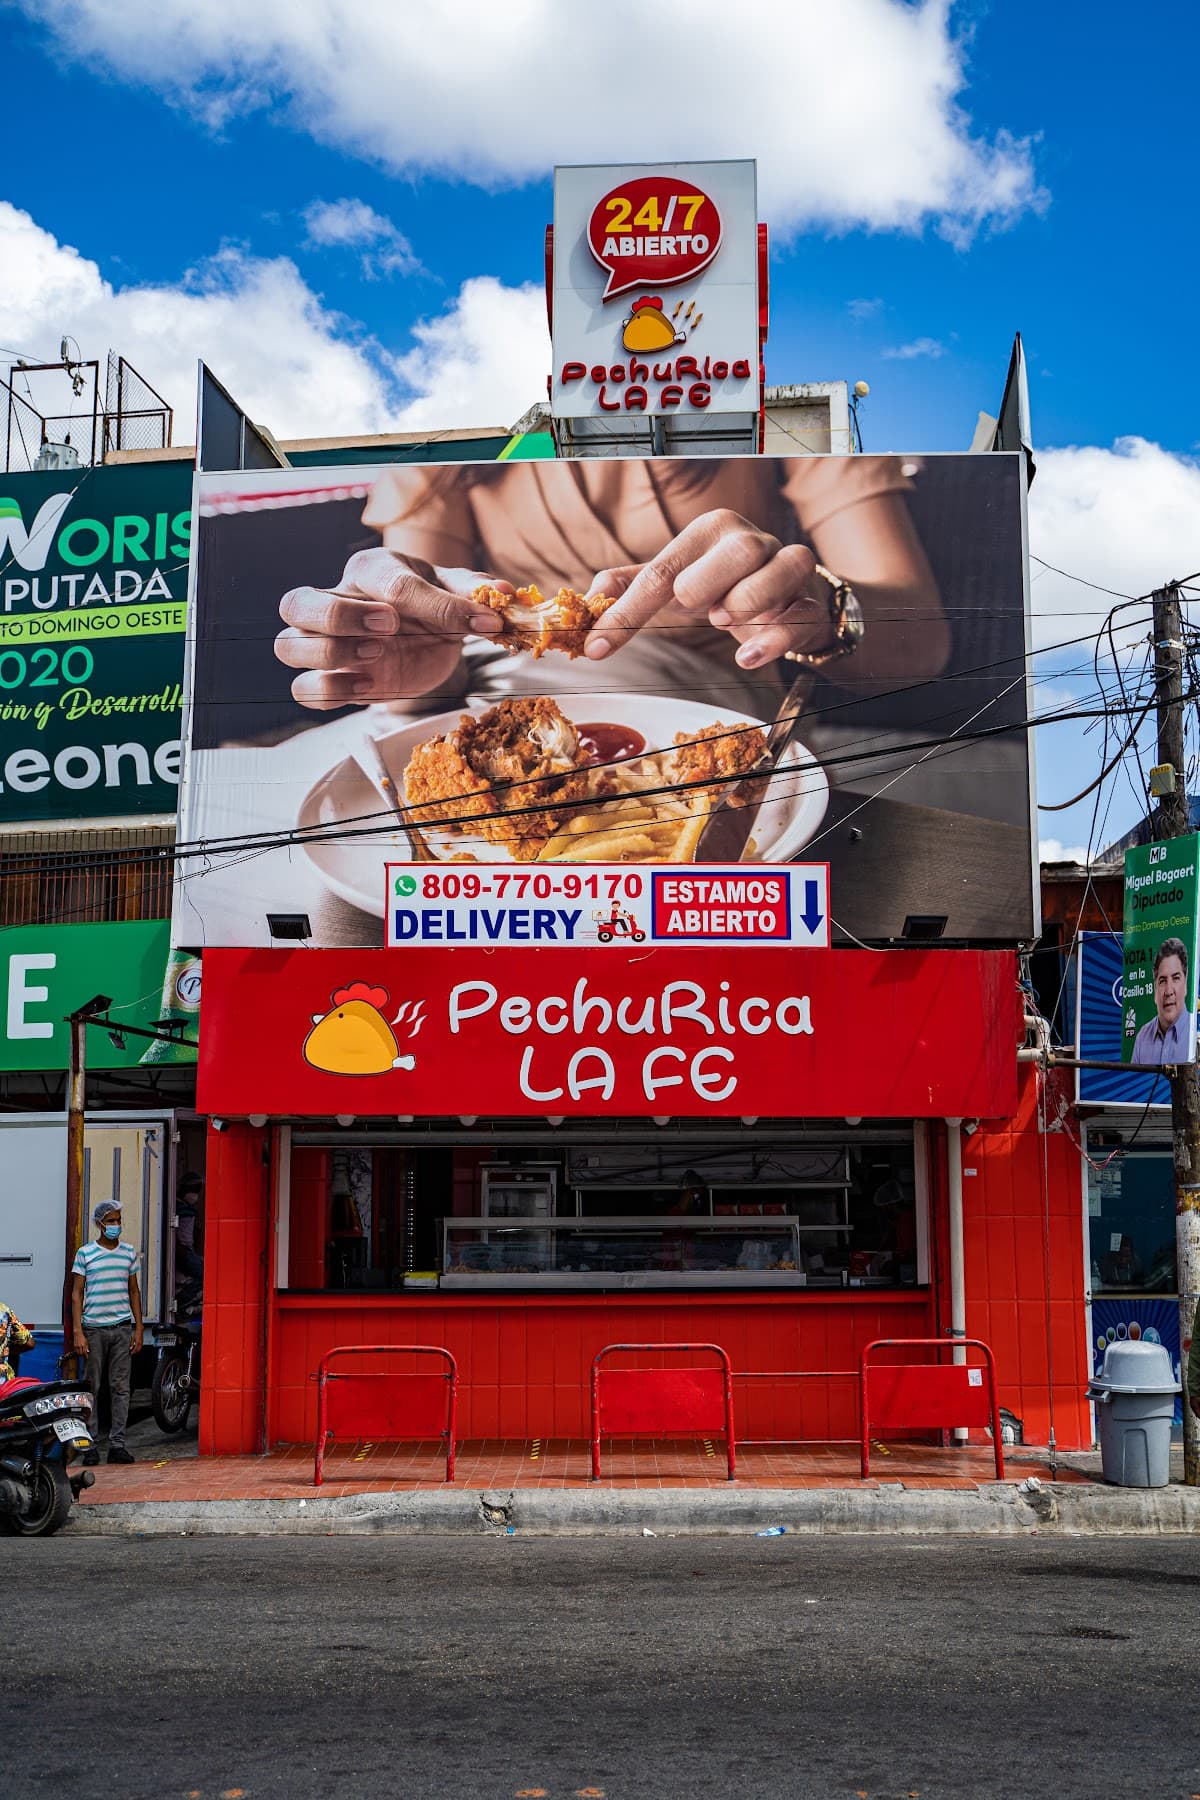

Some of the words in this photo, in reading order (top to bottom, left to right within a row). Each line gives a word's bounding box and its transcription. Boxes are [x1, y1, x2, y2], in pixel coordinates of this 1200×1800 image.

[605, 195, 705, 233] 24/7
[602, 234, 709, 257] ABIERTO
[562, 356, 751, 385] PechuRica
[598, 385, 648, 411] LA
[661, 383, 711, 408] FE
[5, 568, 173, 611] PUTADA
[29, 614, 120, 636] DOMINGO
[126, 609, 182, 629] OESTE
[0, 646, 94, 689] 020
[34, 702, 55, 730] y
[0, 740, 182, 793] eone
[422, 873, 643, 899] 809-770-9170
[1125, 871, 1154, 891] Miguel
[1156, 864, 1194, 884] Bogaert
[662, 880, 781, 904] ESTAMOS
[1132, 887, 1184, 912] Diputado
[395, 909, 582, 940] DELIVERY
[666, 909, 777, 933] ABIERTO
[1142, 920, 1169, 931] Domingo
[1170, 916, 1190, 926] Oeste
[1124, 949, 1147, 965] VOTA
[1149, 948, 1153, 961] 1
[1129, 972, 1138, 981] en
[1138, 968, 1146, 979] la
[1122, 984, 1144, 998] Casilla
[1145, 983, 1153, 995] 18
[449, 977, 814, 1035] PechuRica
[1125, 1029, 1135, 1037] FP
[519, 1046, 615, 1101] LA
[642, 1046, 738, 1101] FE
